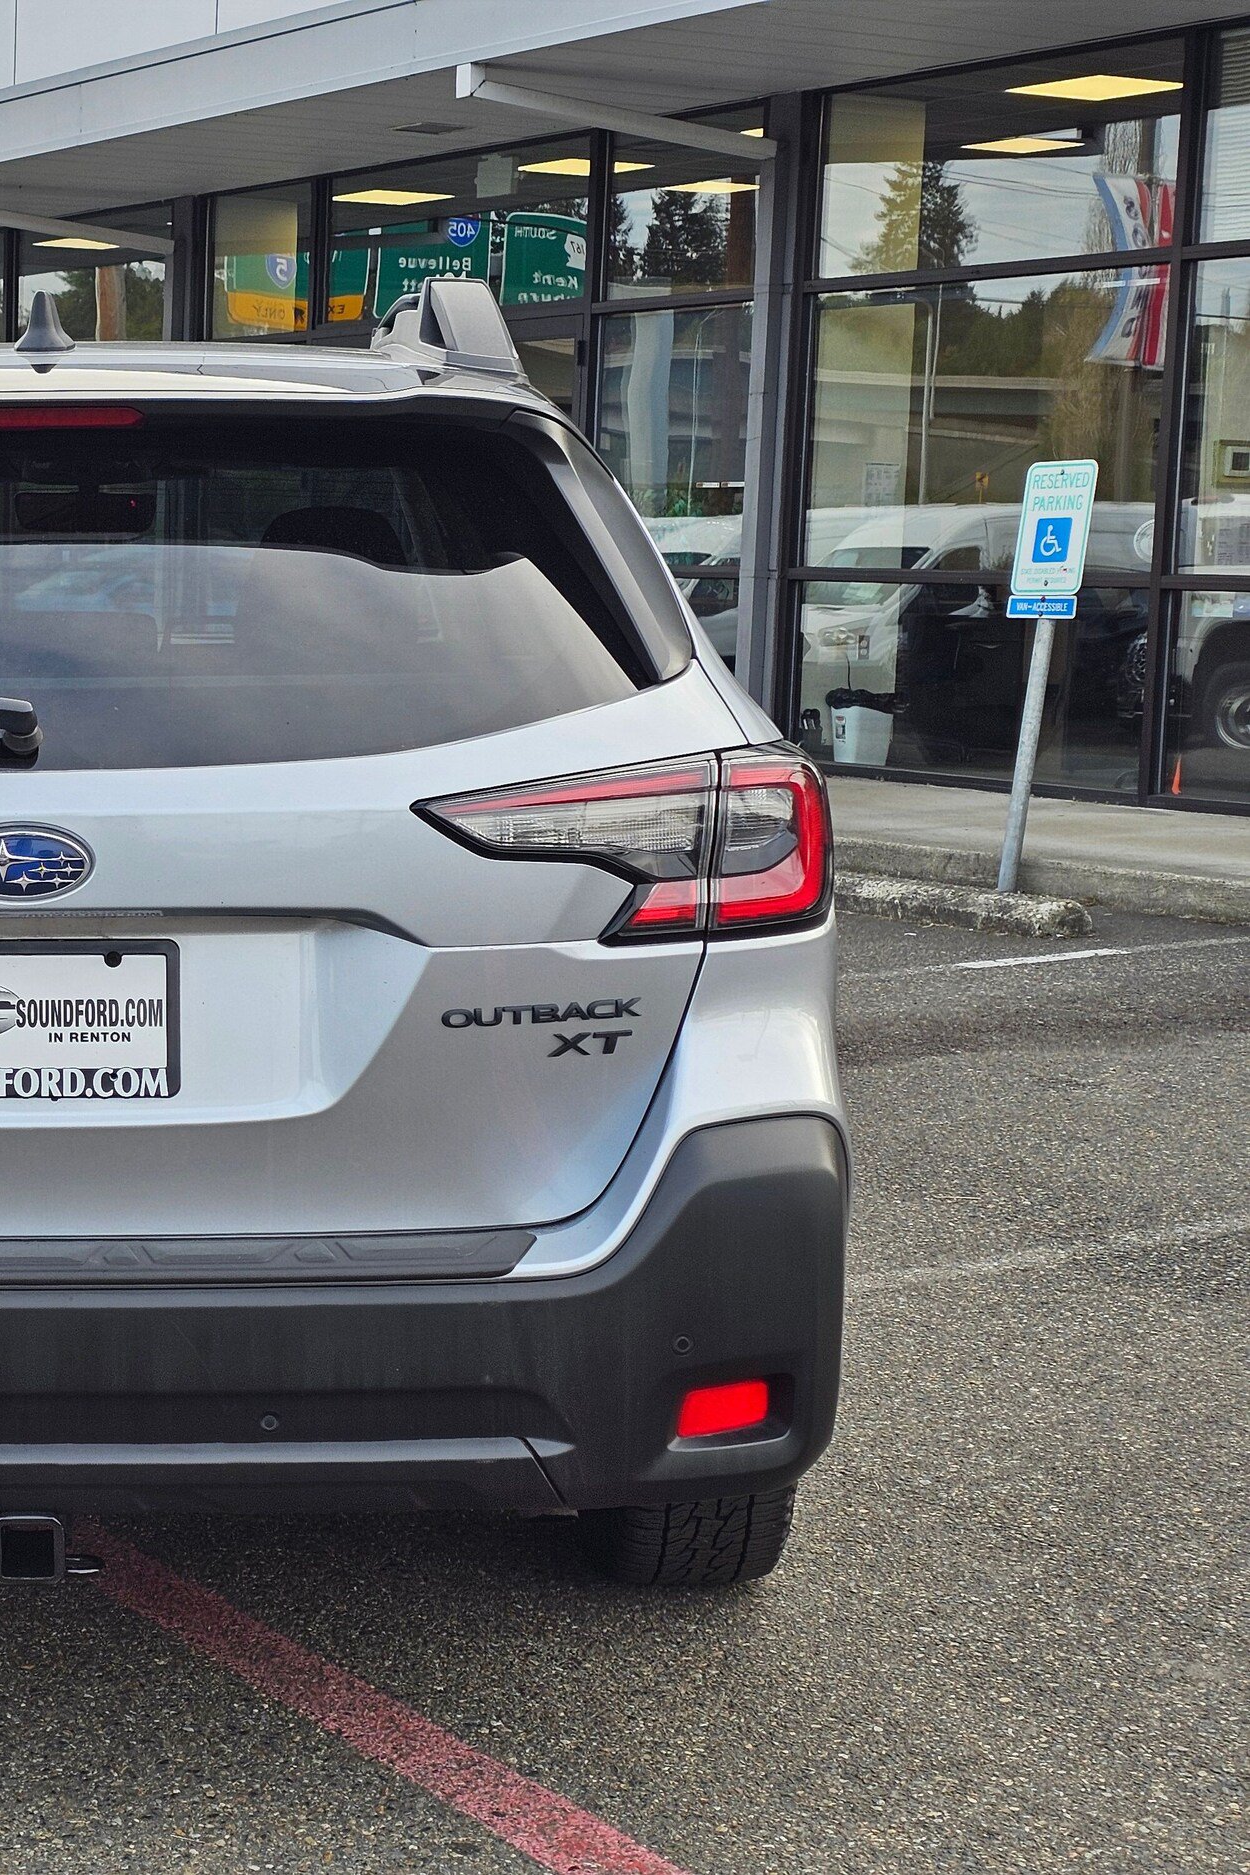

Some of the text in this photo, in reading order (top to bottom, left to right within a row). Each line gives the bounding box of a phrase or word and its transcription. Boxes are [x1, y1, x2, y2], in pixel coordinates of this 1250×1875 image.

[1032, 472, 1090, 490] RESERVED
[1031, 494, 1084, 512] PARKING
[1016, 602, 1069, 612] VAN-ACCESSIBLE
[16, 998, 163, 1028] SOUNDFORD.COM
[441, 997, 642, 1029] OUTBACK
[49, 1032, 132, 1043] IN RENTON
[547, 1029, 633, 1058] XT
